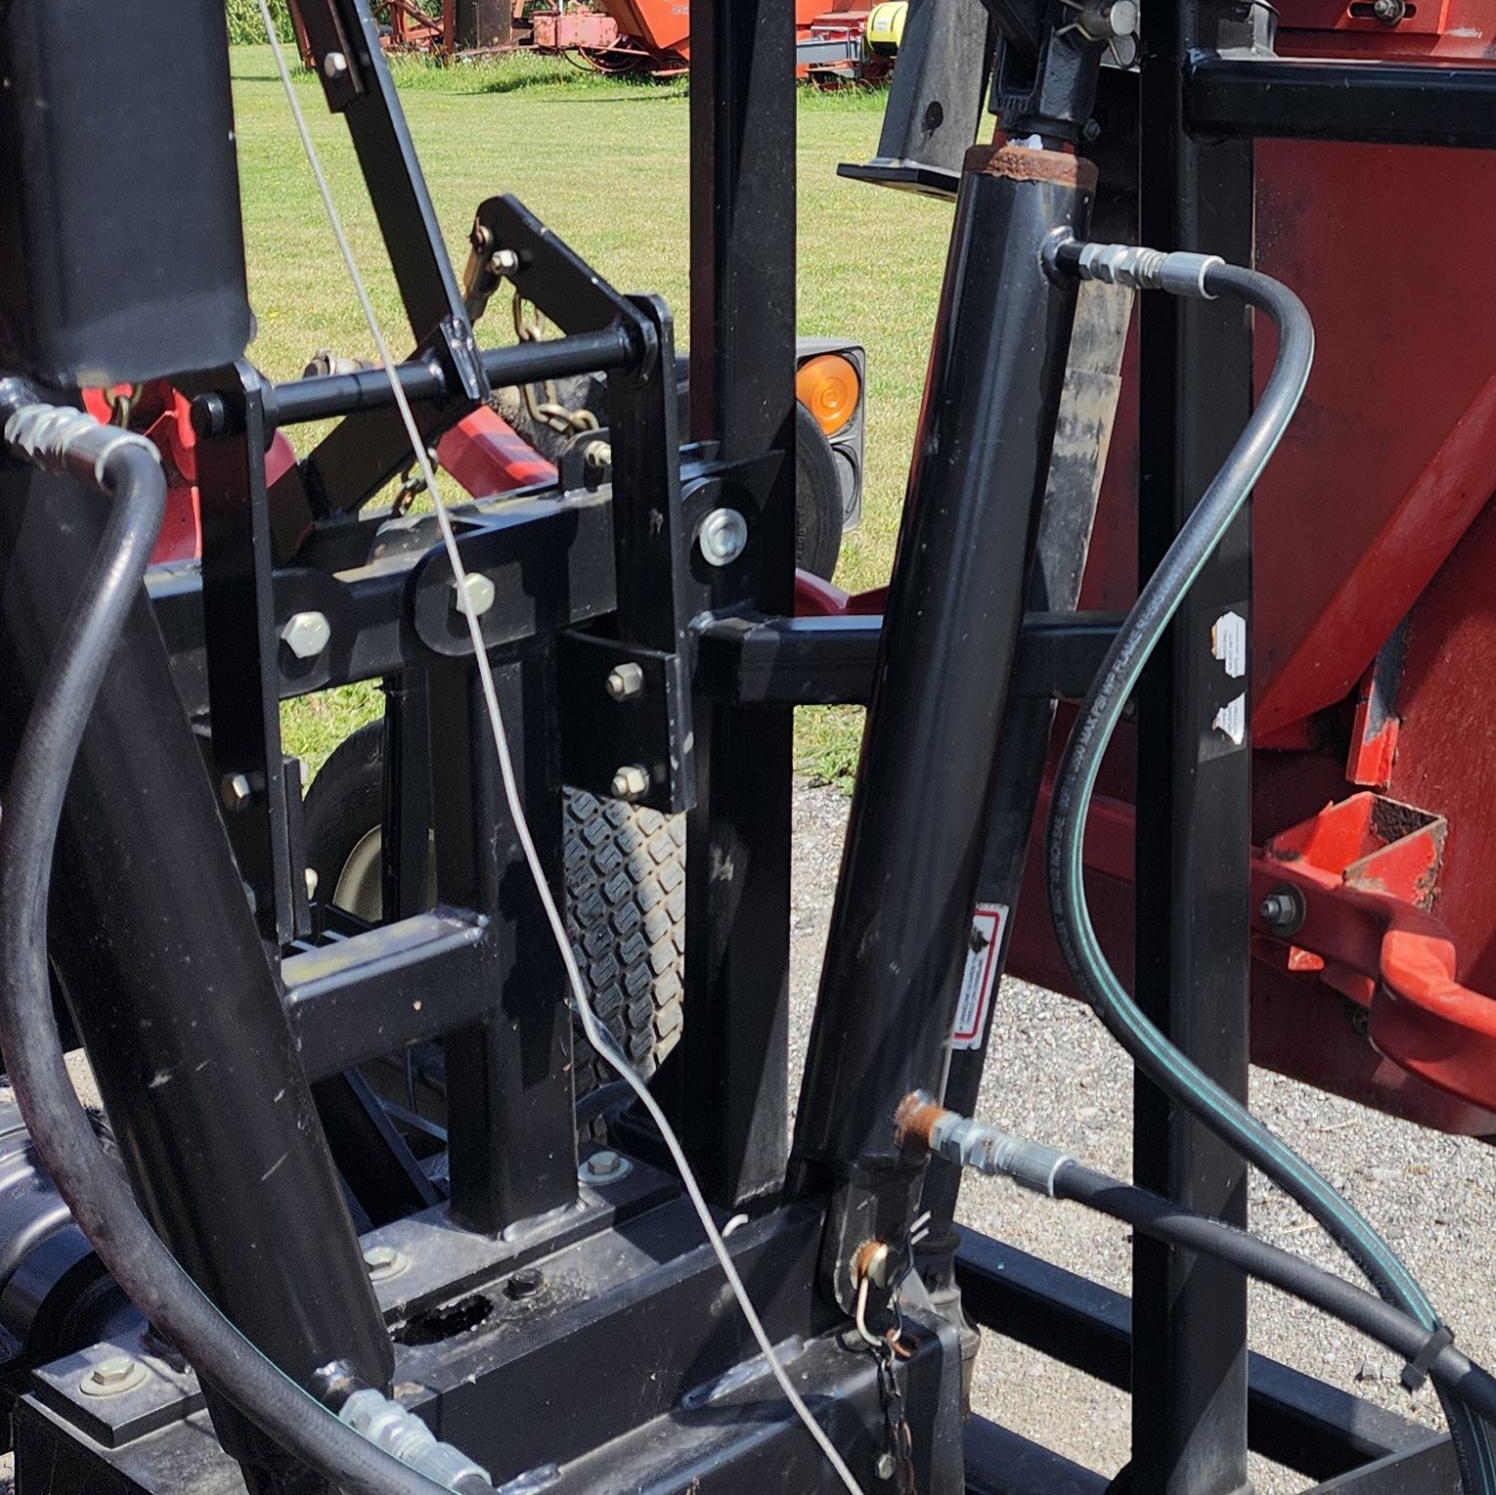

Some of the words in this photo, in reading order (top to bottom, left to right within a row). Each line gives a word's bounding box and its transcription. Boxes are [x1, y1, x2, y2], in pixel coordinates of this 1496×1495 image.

[1080, 714, 1099, 744] MAX
[1091, 693, 1106, 717] PSI
[1112, 631, 1143, 673] FLAME
